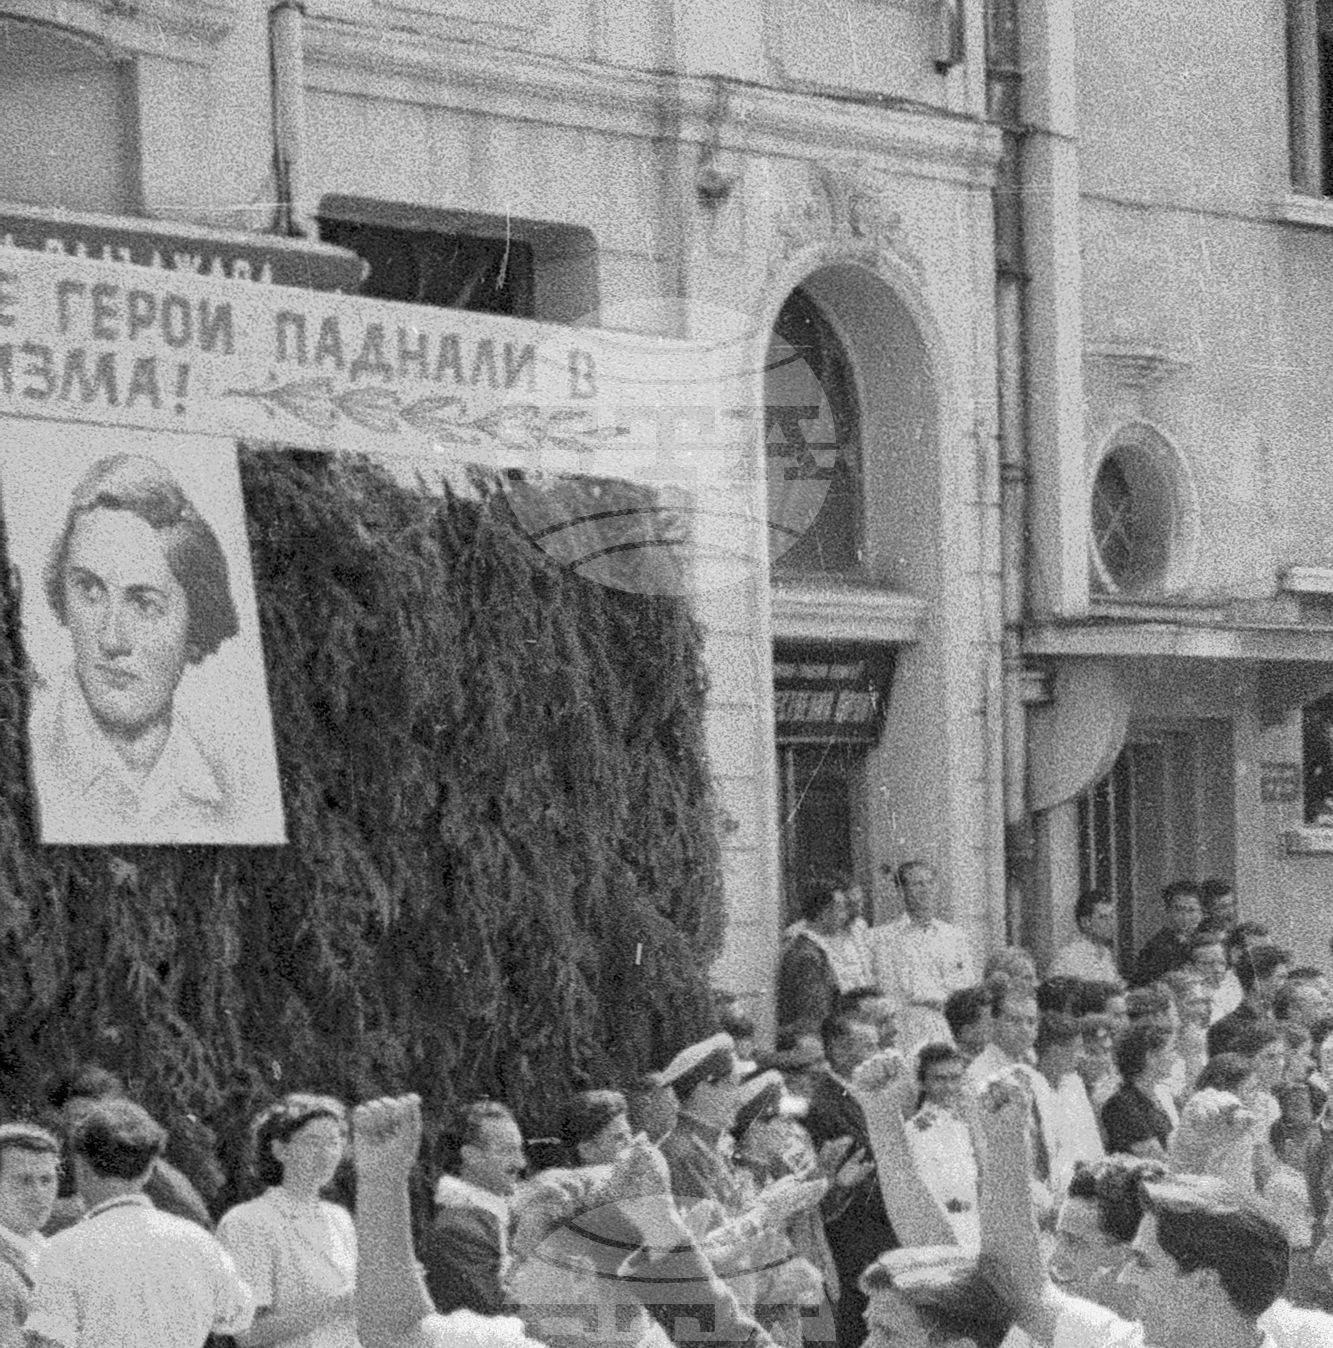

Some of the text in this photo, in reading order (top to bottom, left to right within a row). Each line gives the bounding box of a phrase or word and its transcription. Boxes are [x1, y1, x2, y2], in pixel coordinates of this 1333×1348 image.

[56, 279, 235, 356] ГЕРОИ
[275, 308, 538, 390] ПАДНАЛИ
[566, 346, 599, 400] В
